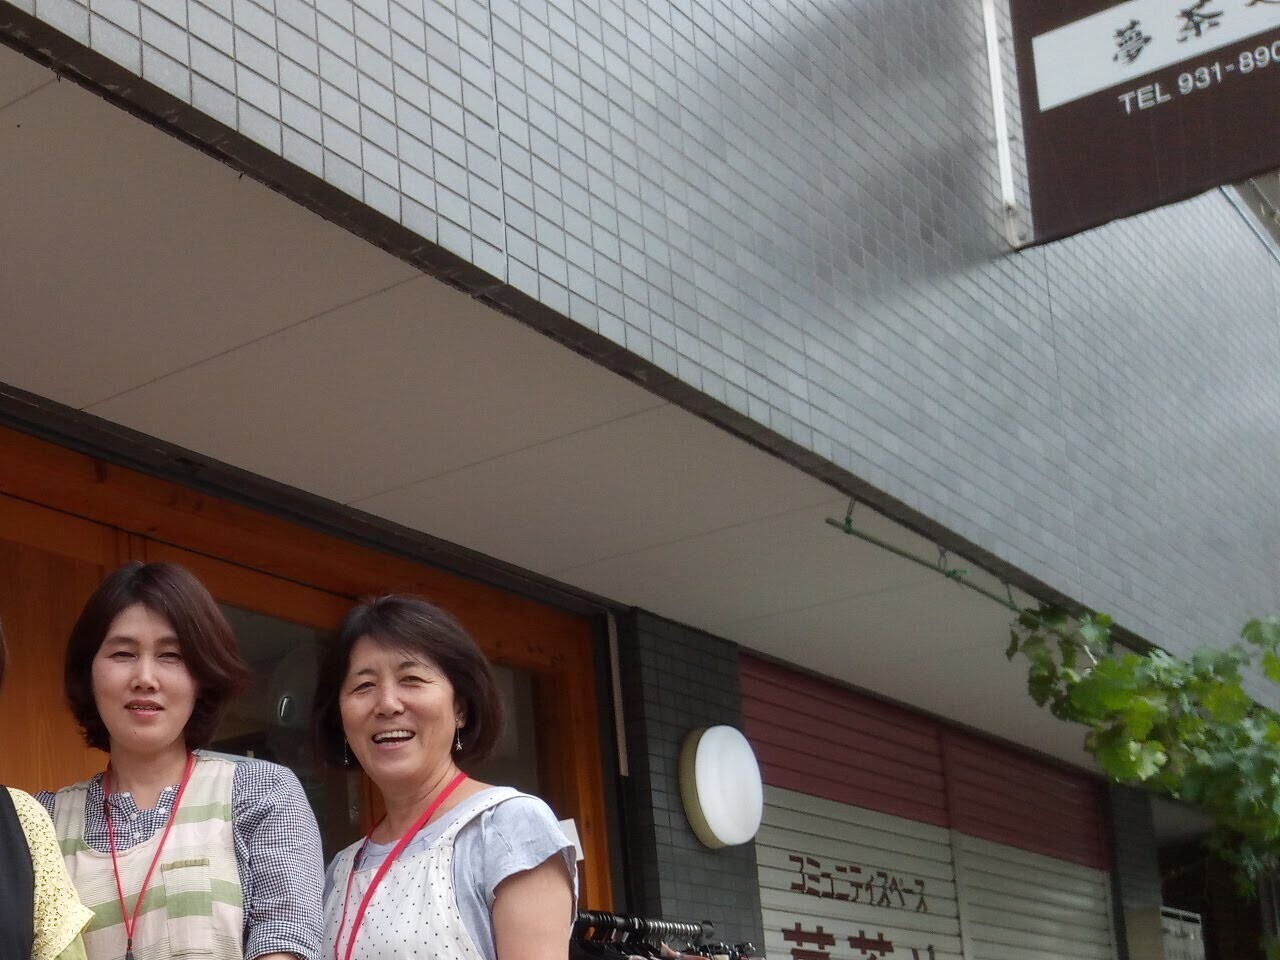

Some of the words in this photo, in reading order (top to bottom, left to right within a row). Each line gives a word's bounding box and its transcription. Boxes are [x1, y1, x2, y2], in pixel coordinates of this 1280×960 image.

[1118, 82, 1171, 114] TEL
[789, 854, 928, 912] コミュニティスペース
